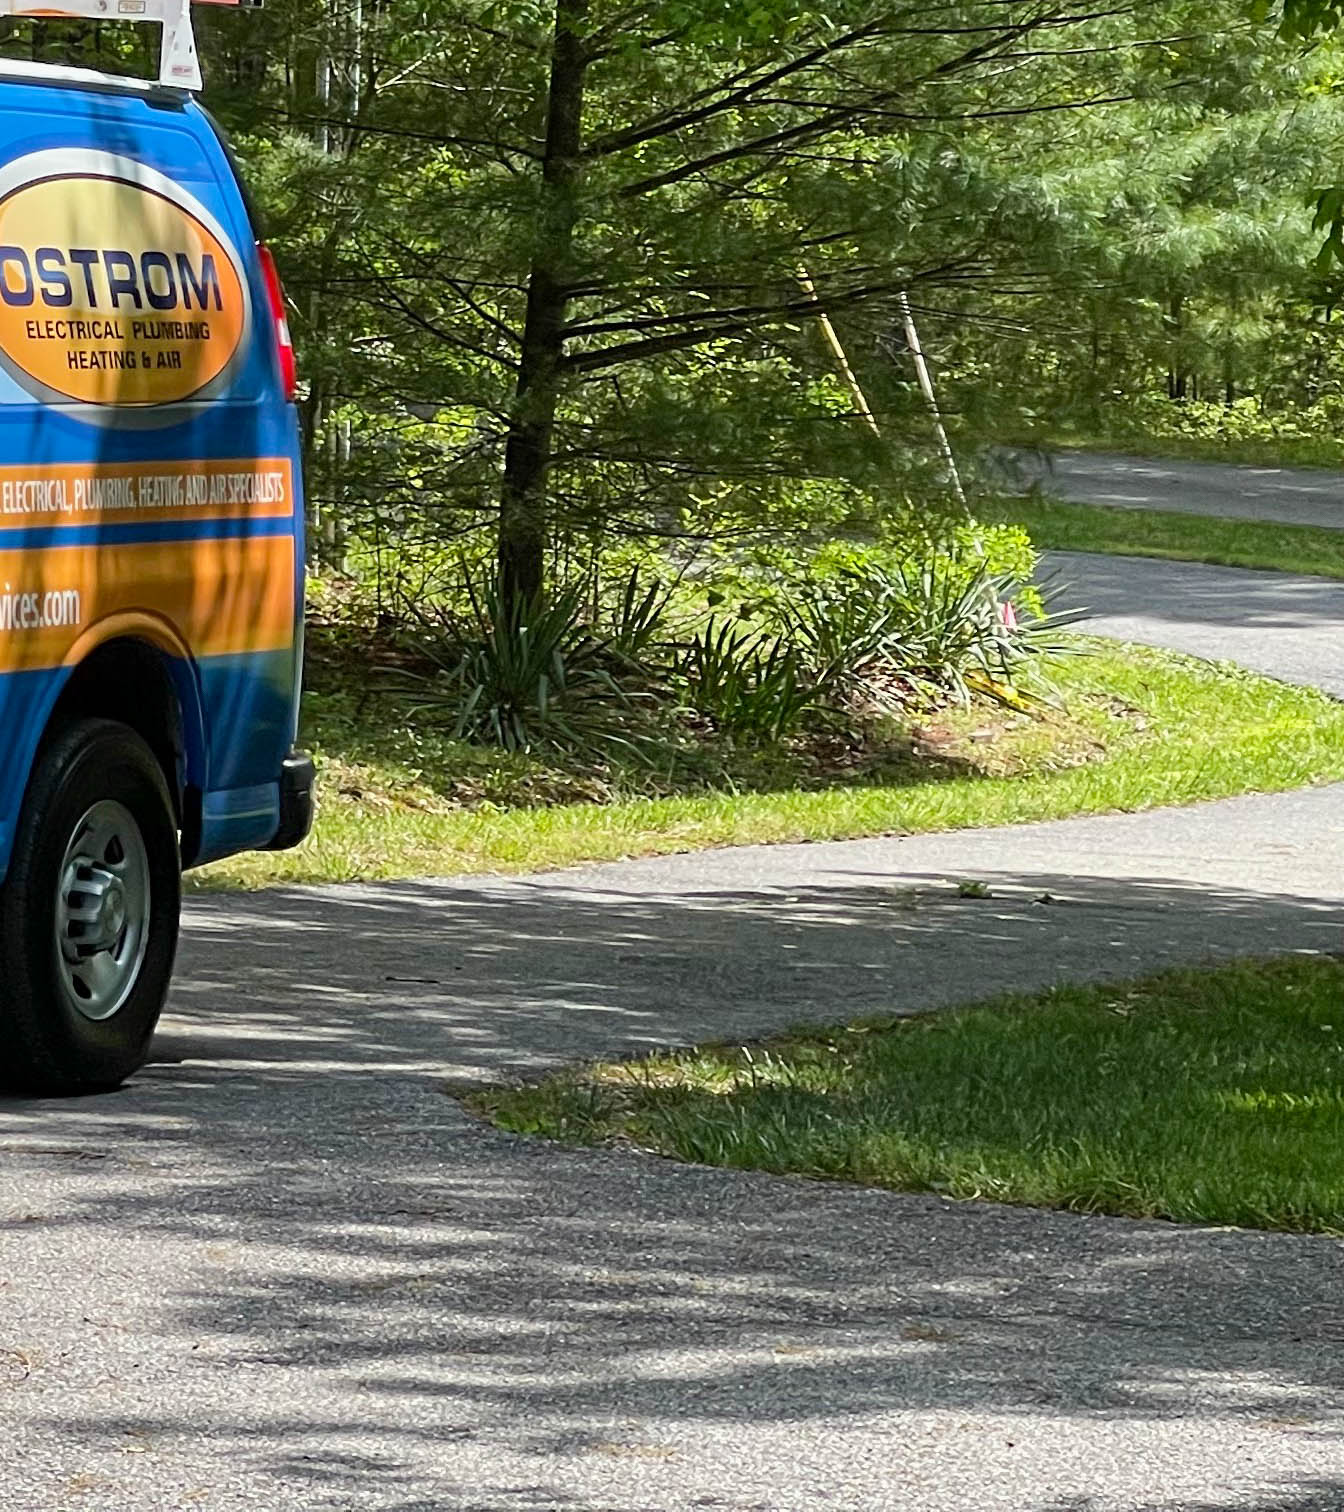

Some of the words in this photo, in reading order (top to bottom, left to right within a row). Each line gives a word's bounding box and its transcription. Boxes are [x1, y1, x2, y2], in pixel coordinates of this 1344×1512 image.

[26, 320, 124, 340] ELECTRICAL
[133, 321, 210, 340] PLUMBING
[67, 351, 137, 369] HEATING
[142, 352, 151, 369] &
[157, 351, 182, 369] AIR
[2, 479, 73, 515] ELECTRICAL,
[74, 477, 137, 511] PLUMBING,
[138, 475, 184, 507] HEATING
[185, 474, 207, 506] AND
[209, 474, 226, 504] AIR
[228, 472, 284, 504] SPECIALISTS
